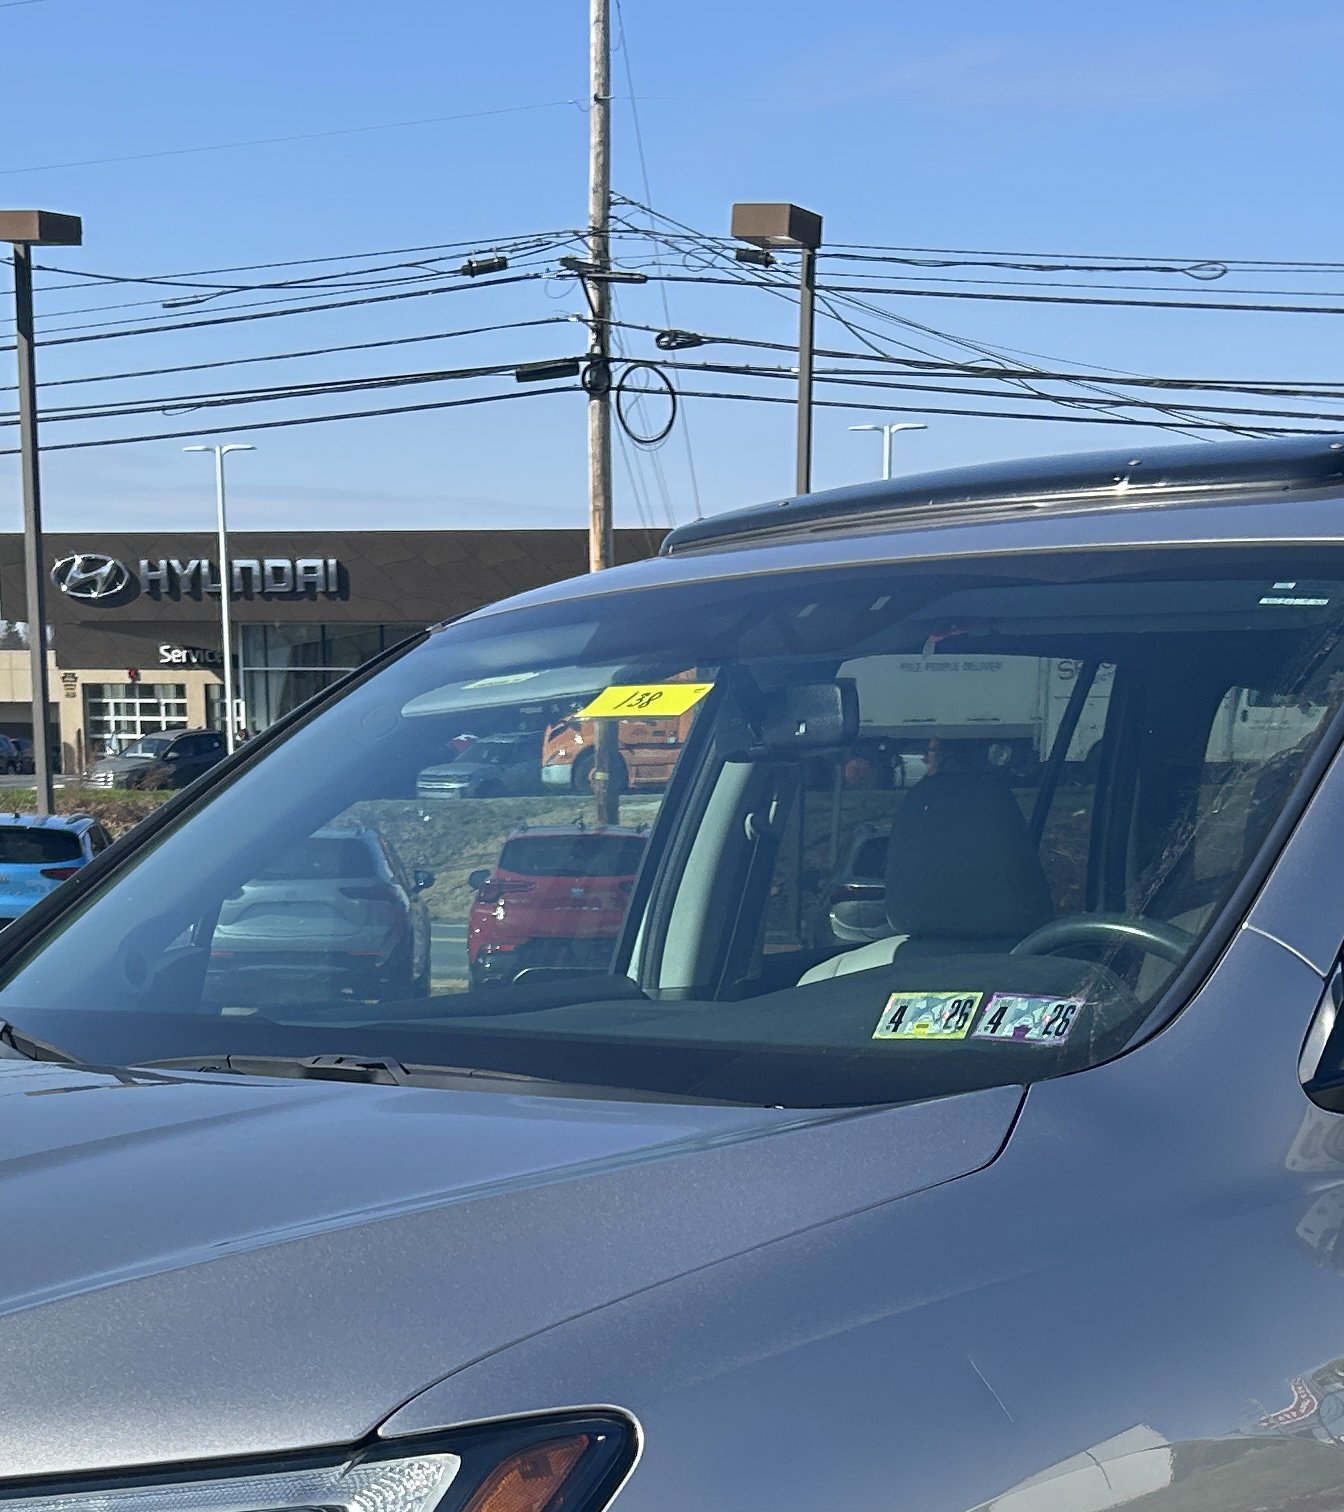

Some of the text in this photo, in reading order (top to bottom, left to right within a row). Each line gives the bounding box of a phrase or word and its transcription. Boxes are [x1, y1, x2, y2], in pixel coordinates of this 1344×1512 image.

[139, 558, 339, 593] HYUNDAI
[613, 690, 664, 709] 138
[888, 999, 974, 1032] 4 26
[987, 1003, 1077, 1036] 4 26
